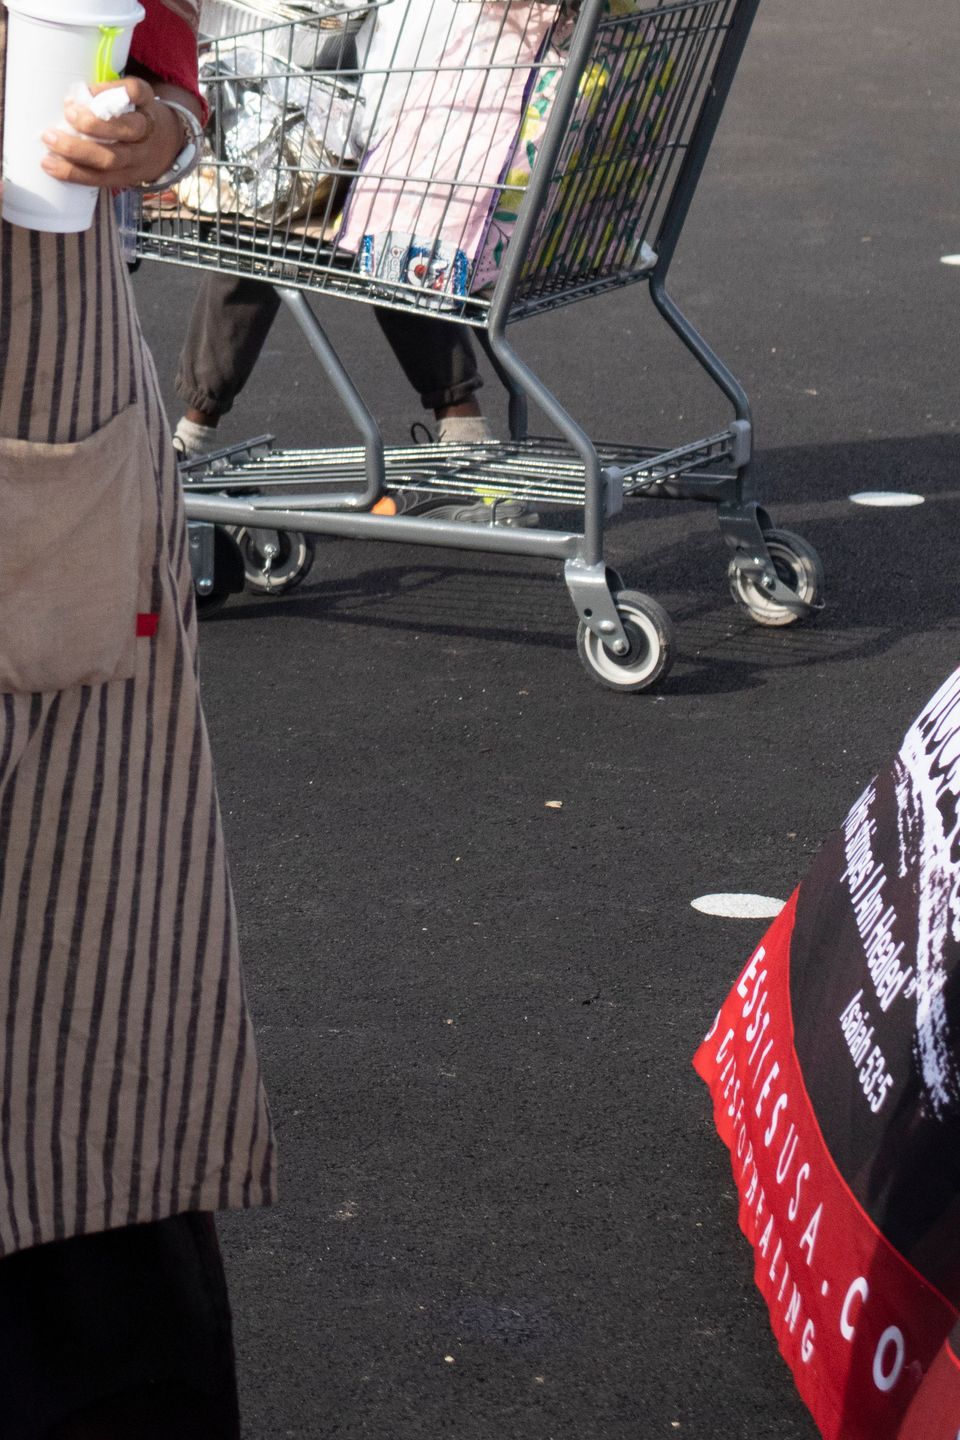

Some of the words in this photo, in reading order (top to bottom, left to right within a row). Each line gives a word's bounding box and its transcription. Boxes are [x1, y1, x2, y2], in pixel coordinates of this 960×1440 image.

[840, 818, 877, 894] stripes
[851, 863, 884, 904] I
[854, 874, 887, 938] Am
[840, 989, 874, 1067] Isaiah
[859, 1045, 893, 1113] 53:5
